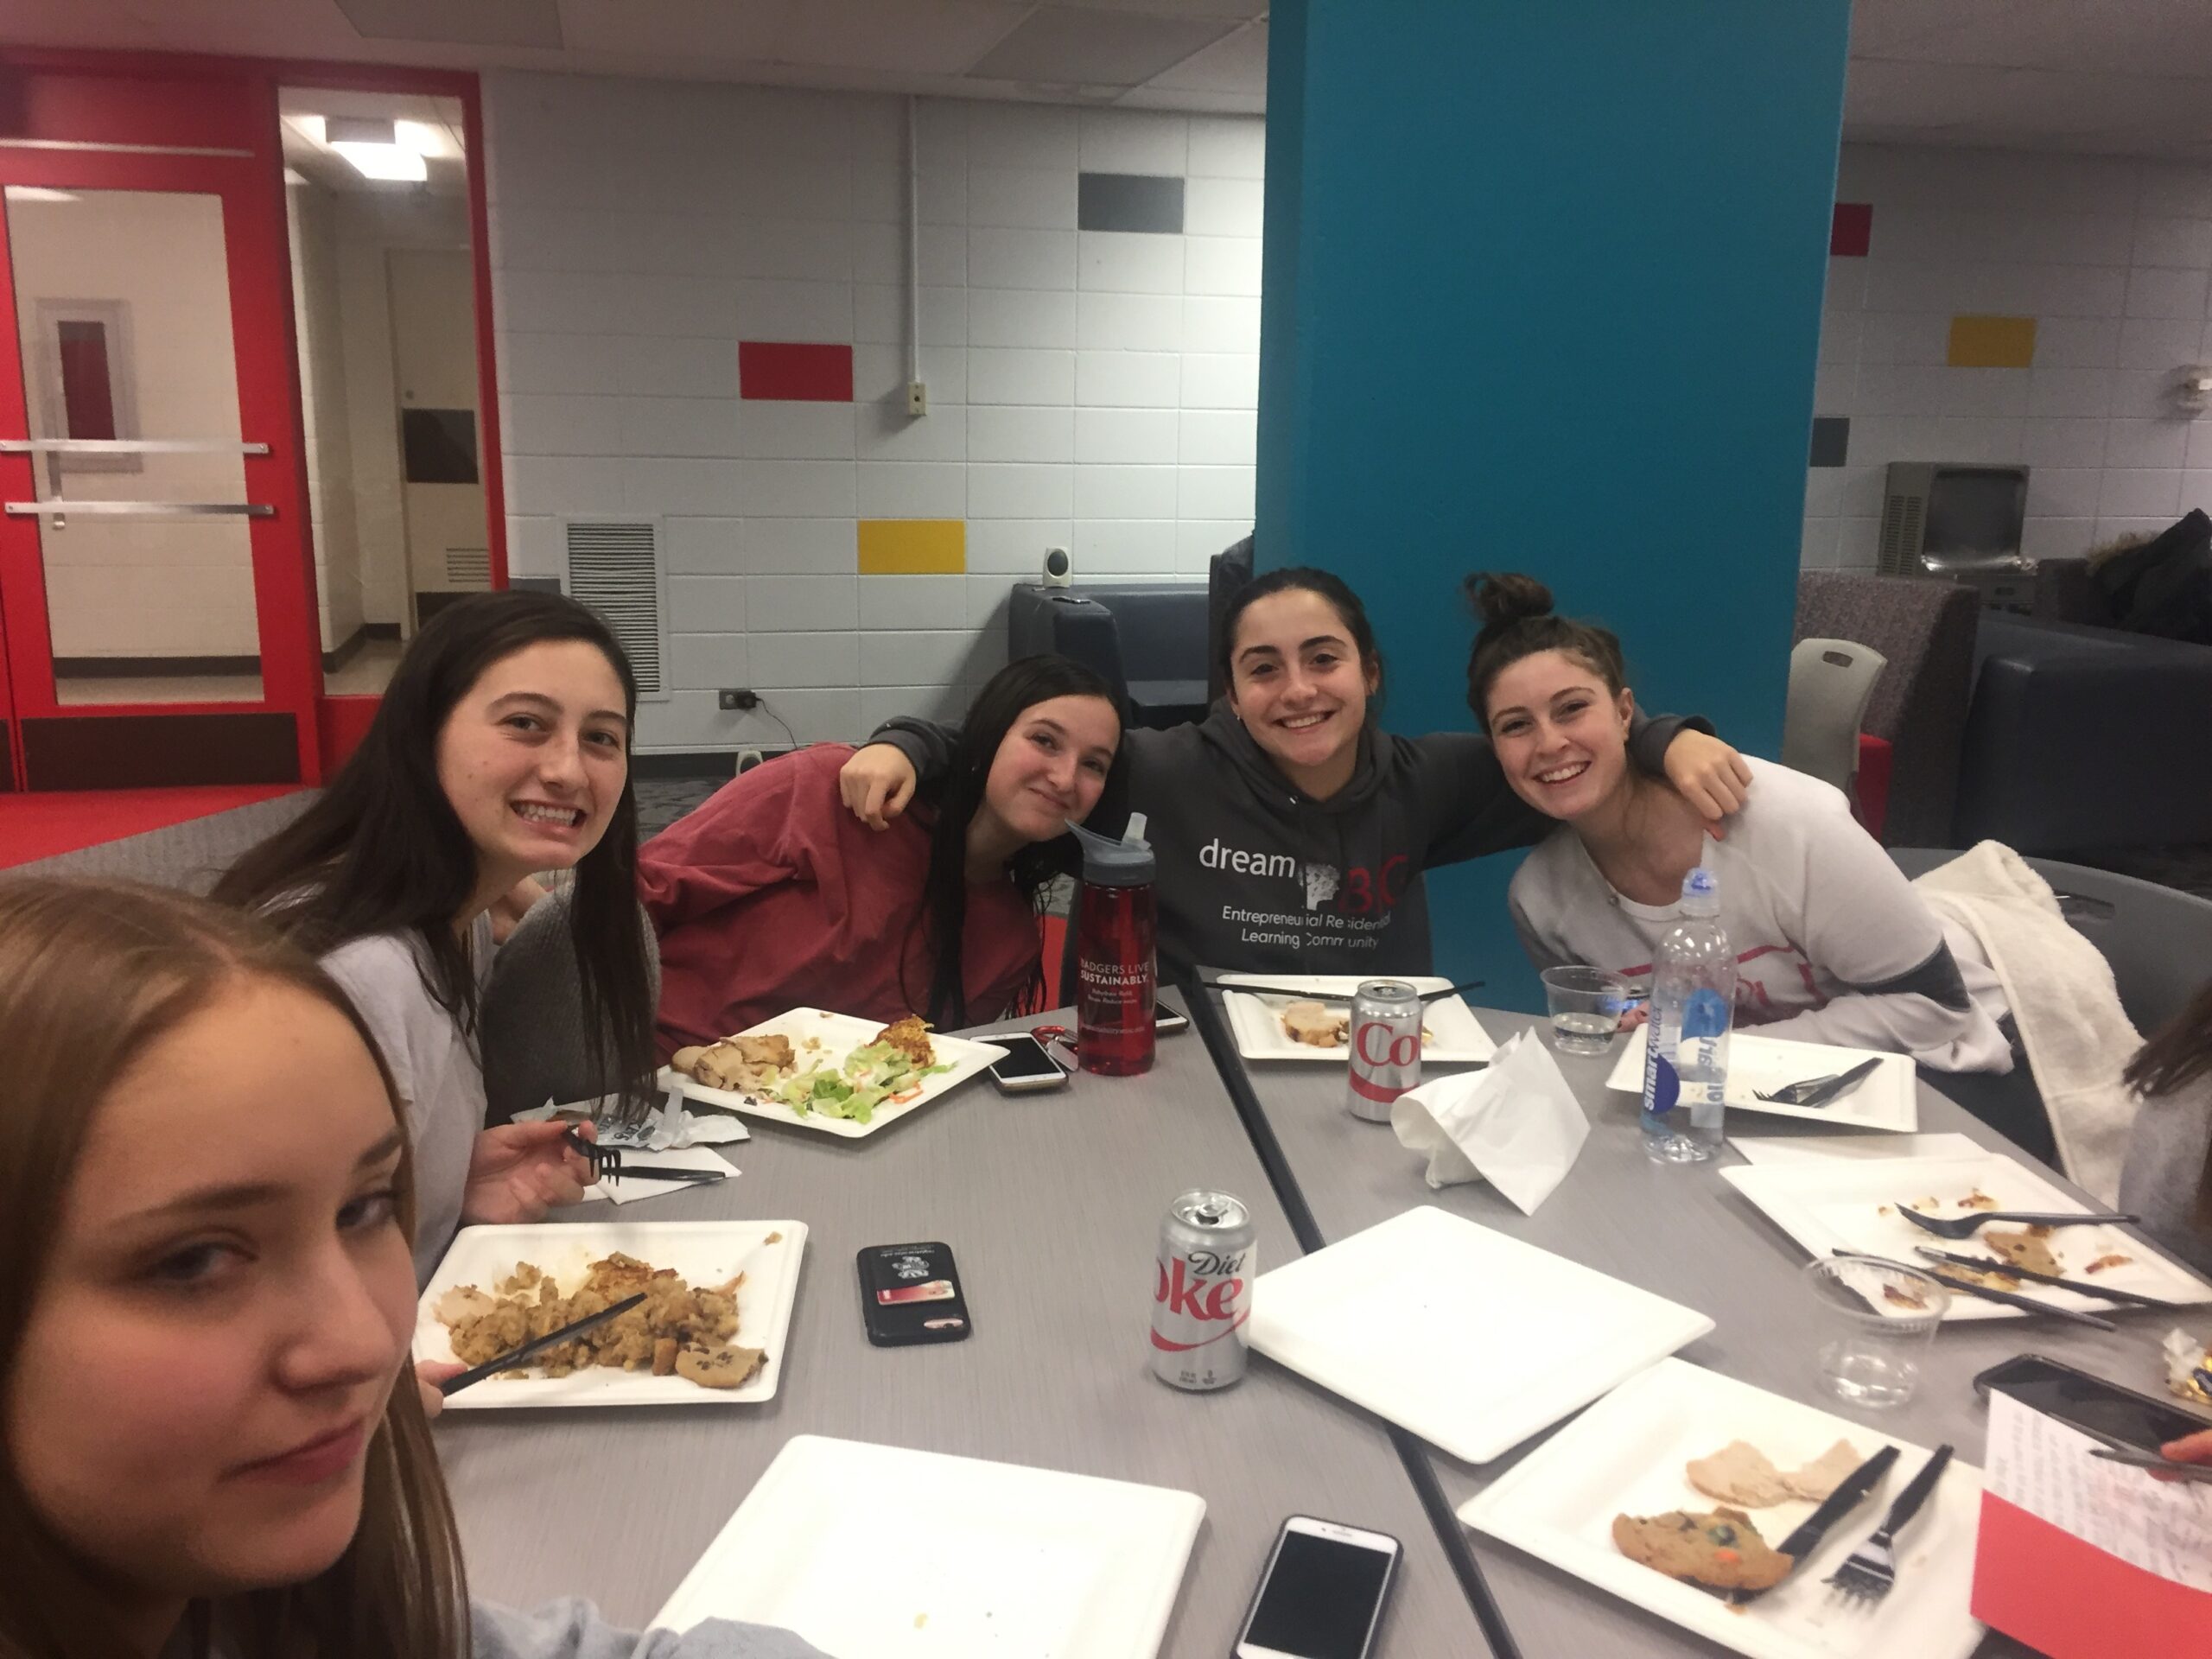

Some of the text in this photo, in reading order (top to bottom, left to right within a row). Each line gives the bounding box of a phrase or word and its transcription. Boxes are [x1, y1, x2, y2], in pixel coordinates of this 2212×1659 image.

[1199, 837, 1295, 878] dream
[1242, 928, 1300, 950] Learning
[1128, 962, 1149, 975] LIVE
[1643, 1005, 1662, 1111] smartwater
[1188, 1250, 1245, 1276] Diet
